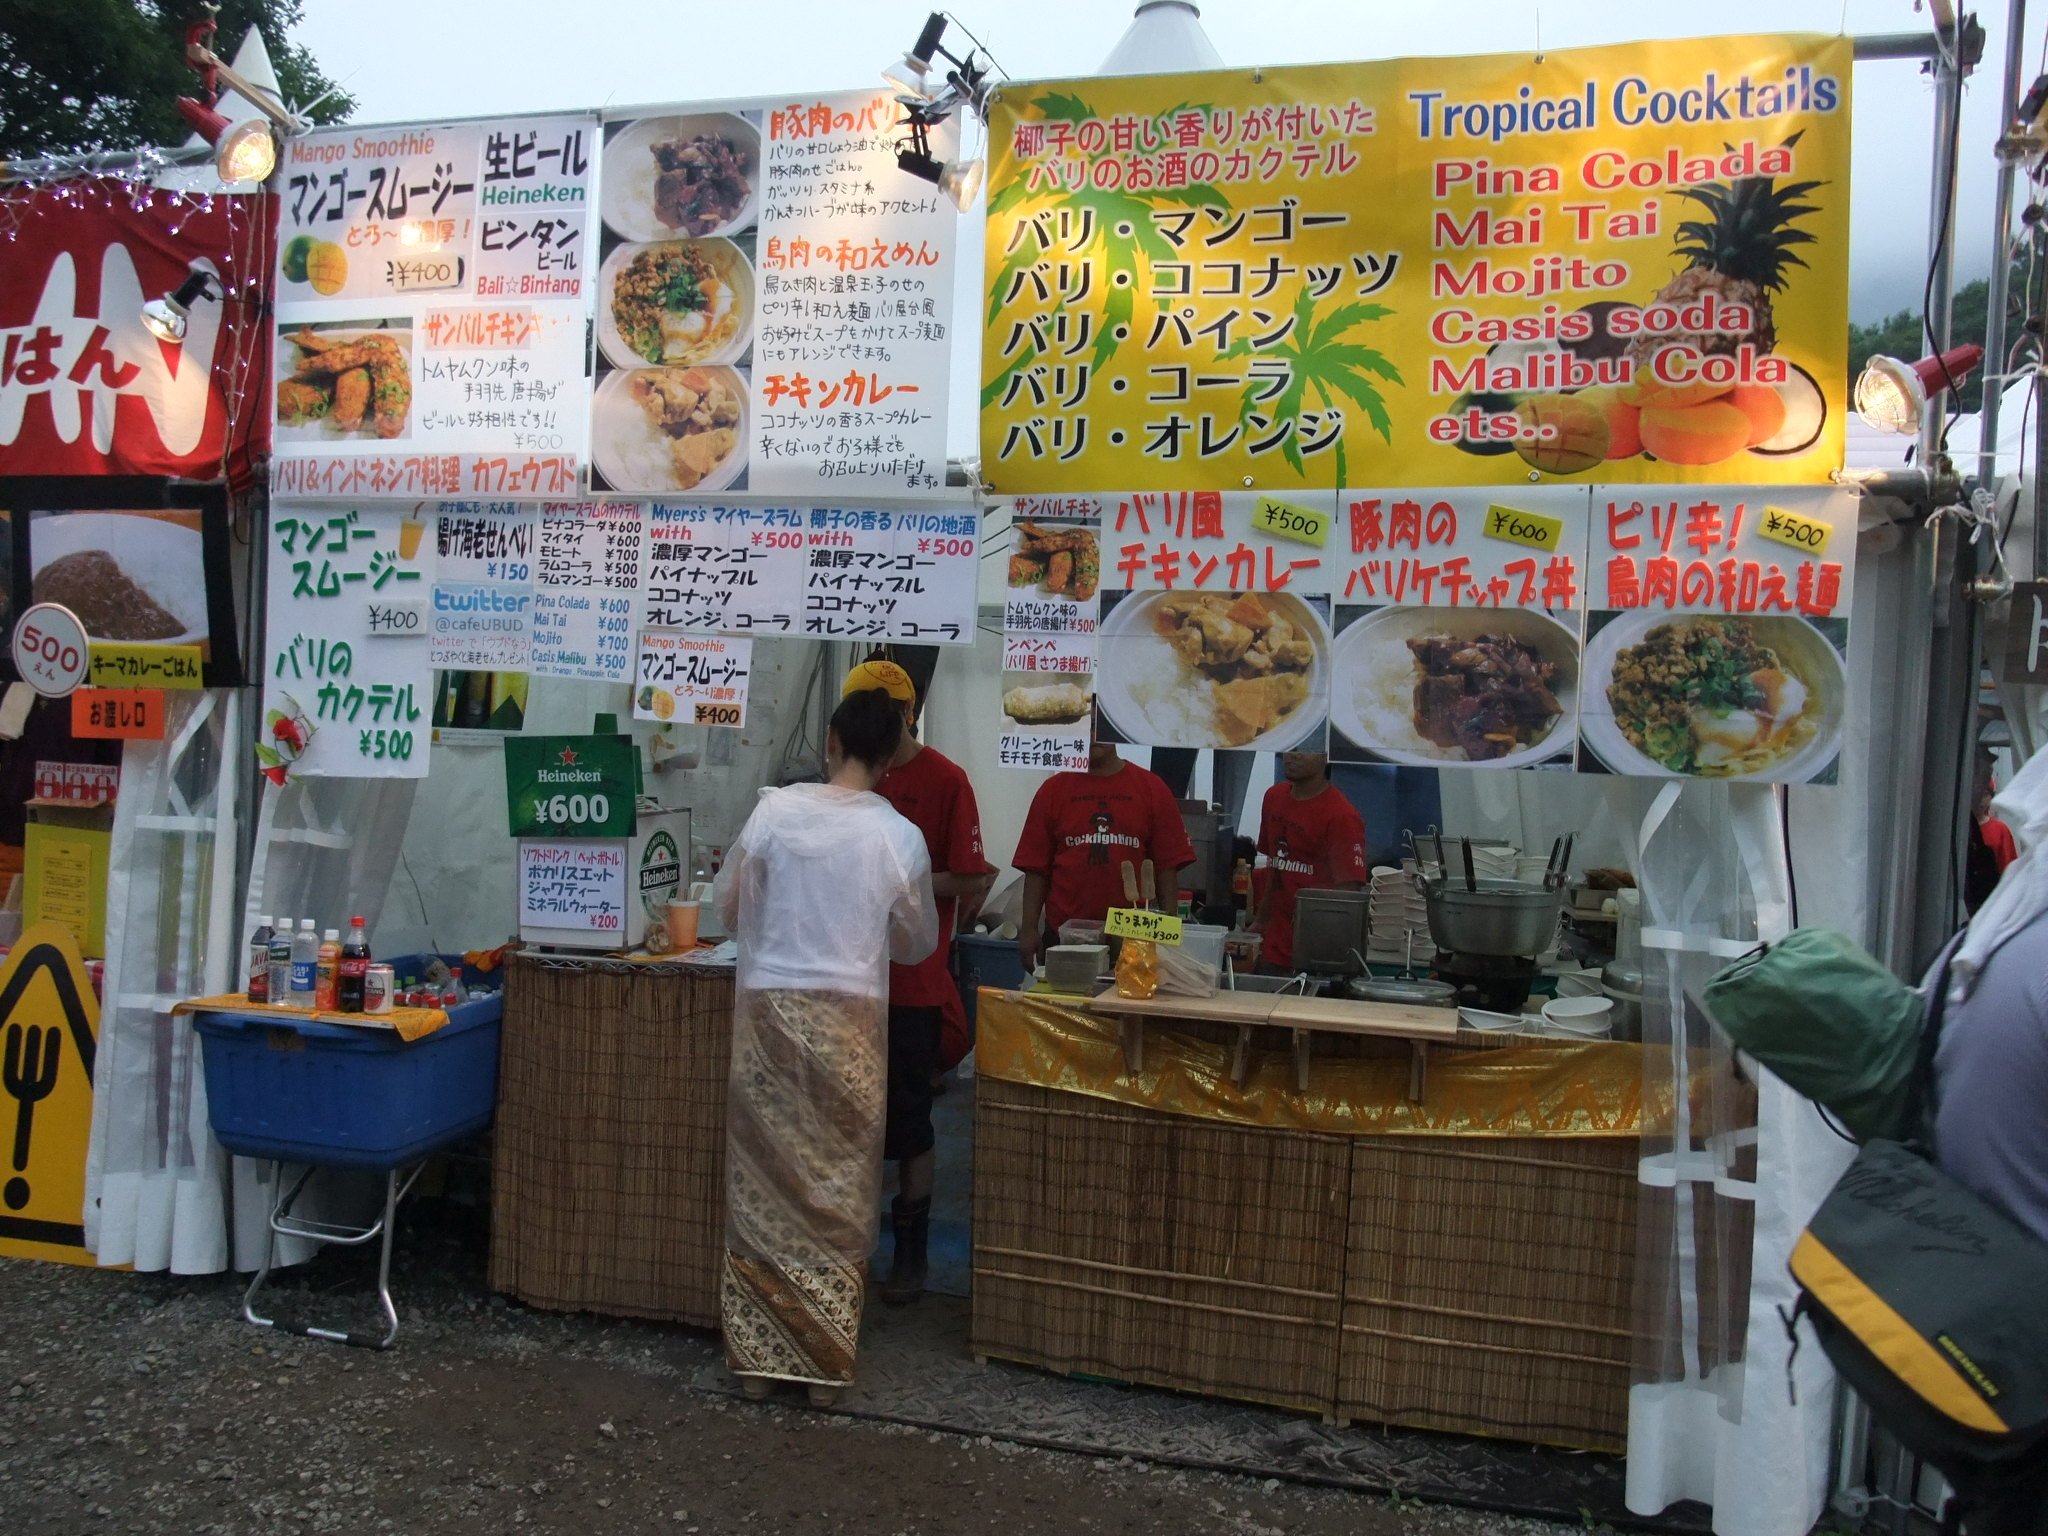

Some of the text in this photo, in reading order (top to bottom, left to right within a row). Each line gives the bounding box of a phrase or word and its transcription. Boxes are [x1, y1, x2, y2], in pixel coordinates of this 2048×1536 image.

[1410, 67, 1836, 141] Tropical Cocktails
[1015, 101, 1373, 158] 椰子の甘い香りが付いた
[291, 133, 434, 164] Mango Smoothie
[485, 130, 588, 182] 生ビール
[1029, 142, 1356, 190] バリのお酒のカクテル
[1436, 142, 1792, 197] Pina Colada
[289, 162, 474, 227] マンゴースムージー
[482, 183, 585, 207] Heineken
[482, 218, 579, 251] ビンタン
[1007, 198, 1346, 252] バリ・マンゴー
[1435, 201, 1658, 247] Mai Tai
[538, 252, 577, 271] ビール
[763, 235, 939, 272] 鳥肉の和えめん
[397, 261, 451, 287] ¥400
[1005, 254, 1399, 304] バリ・ココナッツ
[1434, 257, 1627, 297] Mojito
[428, 312, 530, 346] サンバルチキン
[1003, 308, 1294, 355] バリ・パイン
[1431, 295, 1750, 344] Casis soda
[762, 344, 891, 362] にもアレンジできます。
[422, 355, 530, 382] トムヤムクン味の
[1432, 346, 1787, 392] Malibu Cola
[763, 370, 919, 409] チキンカレー
[1002, 361, 1291, 407] バリ・コーラ
[760, 408, 931, 430] ココナッツの香るスープカレー
[1429, 409, 1556, 441] ets..
[513, 432, 563, 450] ¥500
[1000, 411, 1342, 460] バリ・オレンジ
[276, 456, 461, 494] バリ&インドネシア料理
[906, 473, 938, 489] ます。
[1015, 497, 1102, 516] サンバルチキン
[1115, 491, 1224, 539] バリ風
[1265, 503, 1318, 535] ¥500
[275, 510, 375, 554] マンゴー
[609, 521, 641, 533] ¥600
[810, 508, 976, 536] 椰子の香る バリの地酒
[1350, 499, 1456, 553] 豚肉の
[1493, 511, 1547, 542] ¥600
[1607, 501, 1744, 555] ピリ辛!
[1767, 511, 1824, 546] ¥500
[542, 533, 640, 547] マイタイ ¥600
[650, 525, 803, 549] with ¥500
[808, 531, 974, 556] with ¥500
[540, 546, 638, 561] モヒート ¥700
[652, 543, 768, 563] 濃厚マンゴー
[810, 549, 936, 570] 濃厚マンゴー
[293, 550, 420, 598] スムージー
[488, 562, 528, 580] ¥150
[539, 559, 637, 574] ラムコーラ ¥500
[650, 566, 758, 586] パイナップル
[1117, 543, 1321, 592] チキンカレー
[538, 573, 637, 588] ラムマンゴー ¥500
[808, 572, 925, 593] パイナップル
[1608, 555, 1842, 616] 鳥肉の和え麺
[434, 588, 530, 612] twitter
[535, 594, 630, 613] Pina Colada ¥600
[648, 588, 732, 606] ココナッツ
[807, 595, 897, 614] ココナッツ
[1007, 601, 1078, 617] トムヤムクン味の
[369, 605, 418, 631] ¥400
[435, 617, 523, 633] @cafeUBUD
[534, 612, 628, 632] Mai Tai ¥600
[1006, 615, 1095, 633] 手羽先の唐揚げ ¥500
[21, 625, 79, 672] 500
[533, 630, 628, 650] Mojito ¥700
[642, 634, 725, 653] Mango Smoothie
[94, 655, 198, 678] キーマカレーごはん
[275, 633, 352, 679] バリの
[596, 653, 626, 669] ¥500
[642, 652, 748, 686] マンゴースムージー
[33, 662, 55, 681] えん
[90, 700, 145, 728] お渡し口
[317, 681, 421, 722] カクテル
[695, 705, 740, 724] ¥400
[360, 729, 413, 761] ¥500
[1000, 736, 1085, 753] グリーンカレー味
[1000, 751, 1088, 769] モチモチ食感 ¥300
[537, 769, 602, 783] Heineken
[534, 794, 609, 824] ¥600
[528, 865, 614, 882] ポカリスエット
[643, 867, 678, 887] Heineken
[528, 881, 600, 898] ジャワティー
[528, 897, 621, 914] ミネラルウォーター
[590, 914, 618, 928] ¥200
[1153, 931, 1179, 940] ¥300
